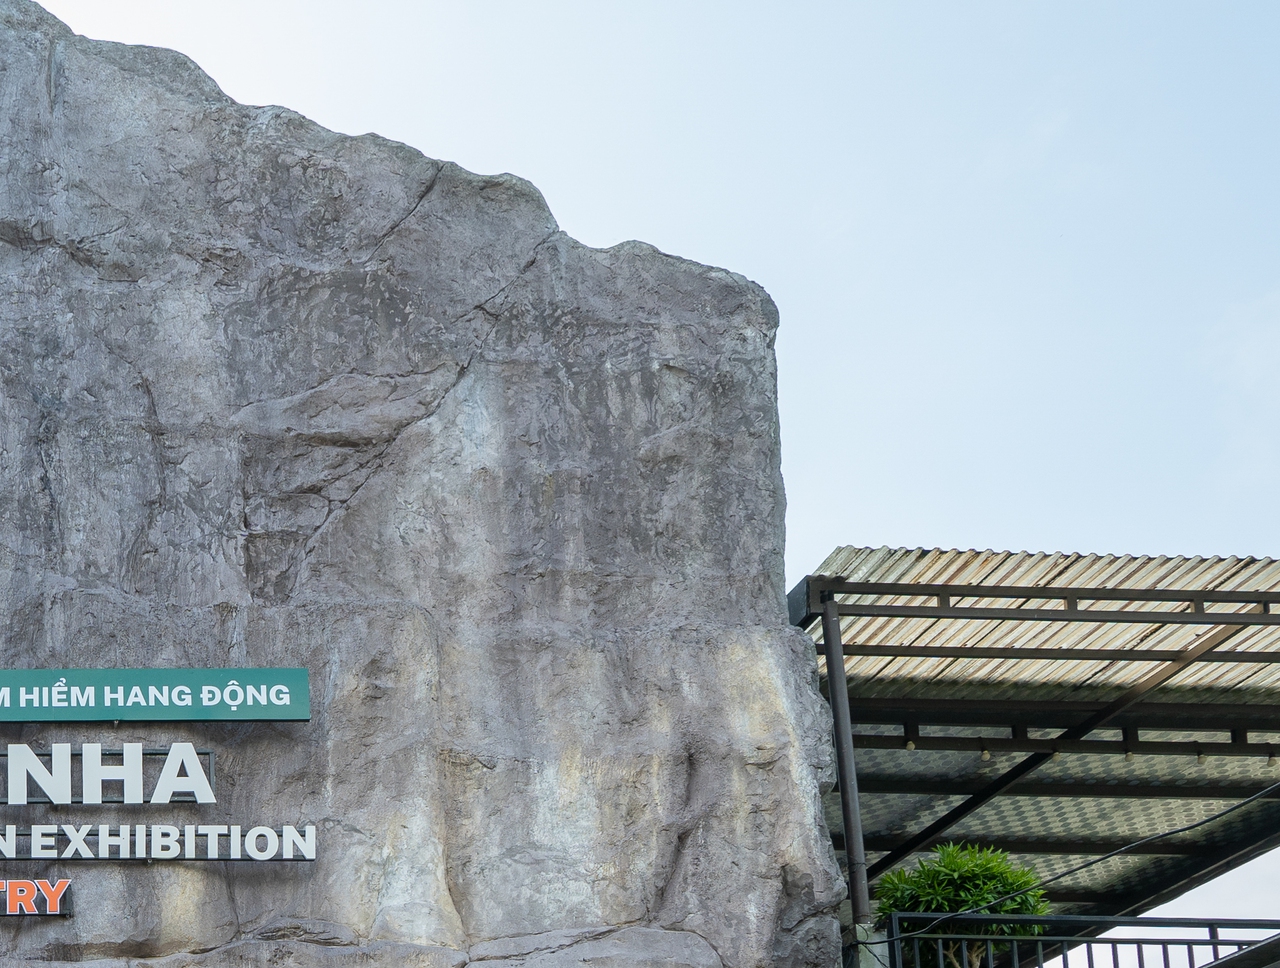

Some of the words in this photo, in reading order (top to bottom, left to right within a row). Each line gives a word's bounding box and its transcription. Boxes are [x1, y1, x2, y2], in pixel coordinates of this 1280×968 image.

[19, 677, 96, 707] HIỂM
[104, 685, 193, 706] HANG
[200, 680, 291, 711] ĐỘNG
[7, 742, 217, 805] NHA
[31, 824, 316, 861] EXHIBITION
